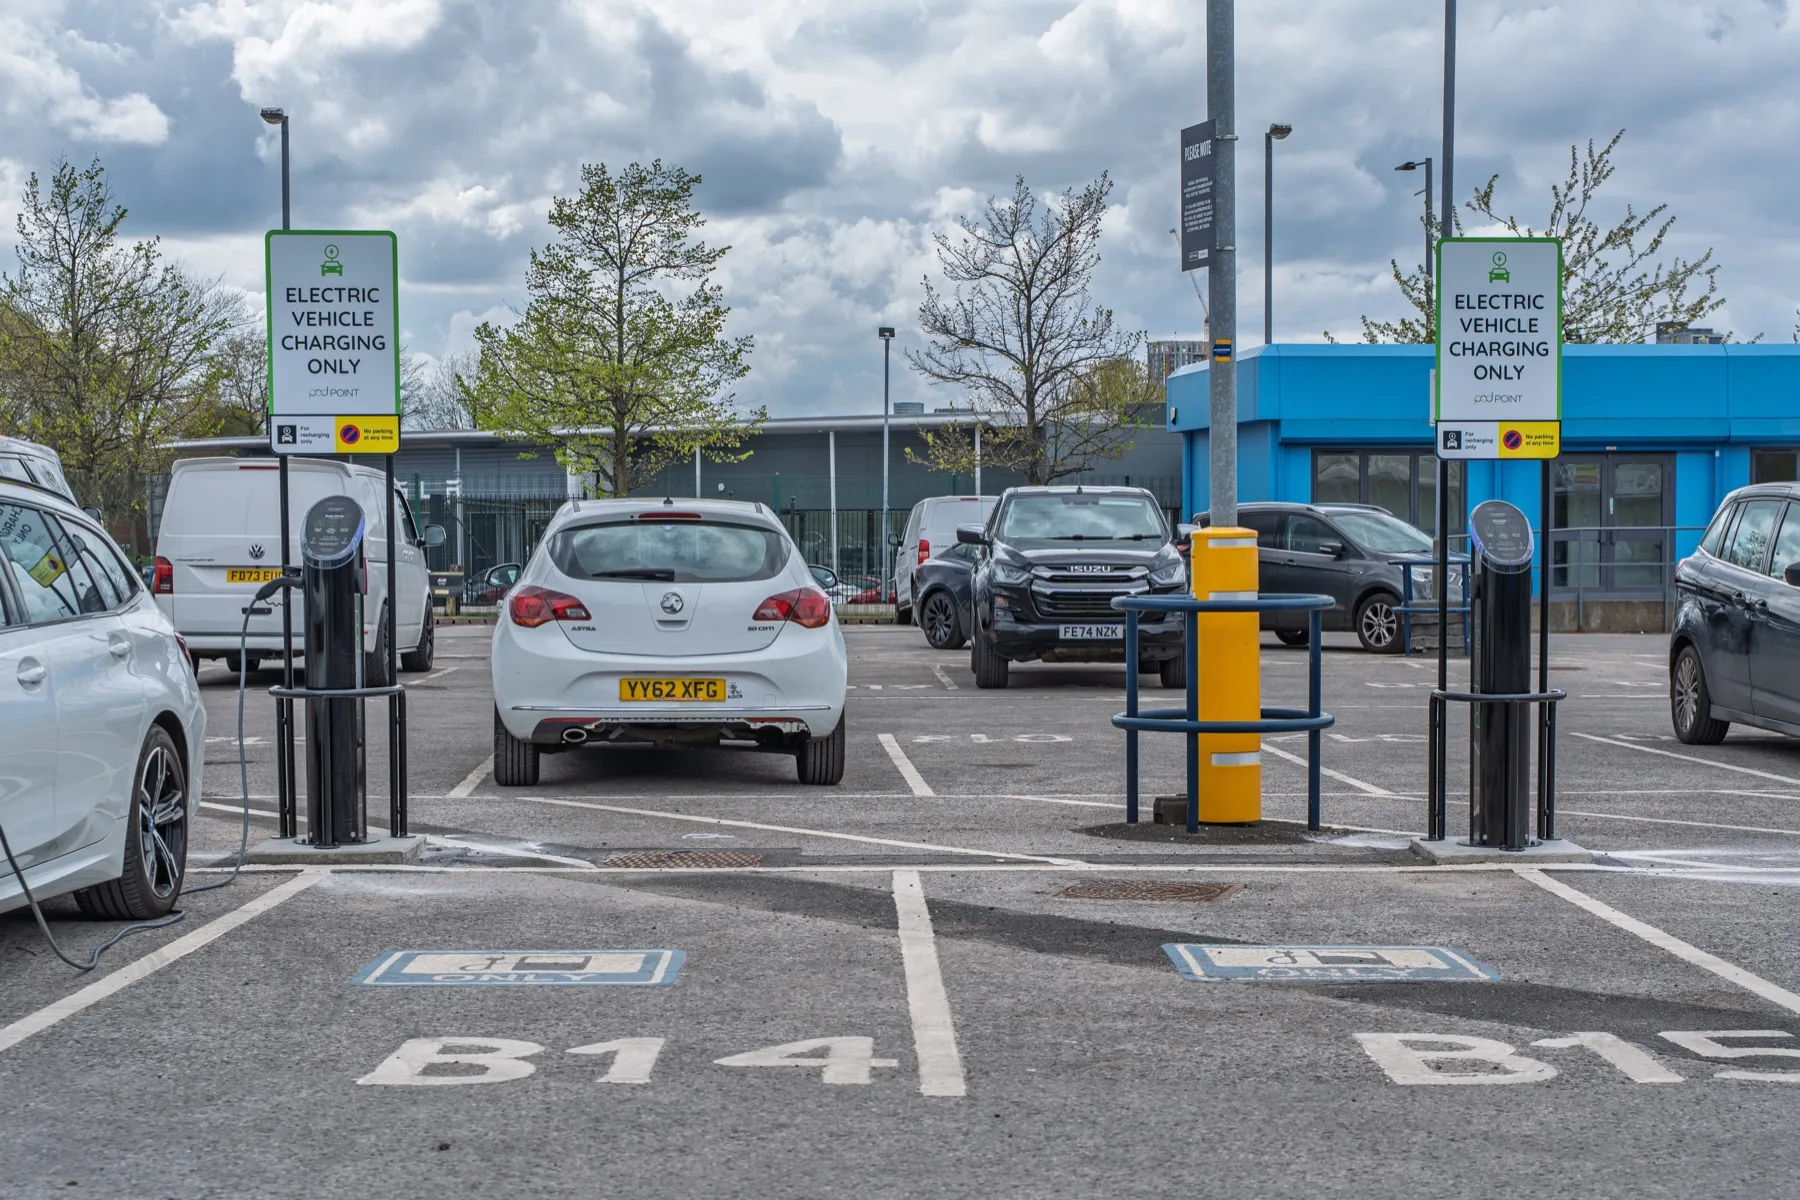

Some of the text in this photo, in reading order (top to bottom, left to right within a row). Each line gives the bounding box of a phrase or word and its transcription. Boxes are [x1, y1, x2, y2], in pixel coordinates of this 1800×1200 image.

[1184, 140, 1212, 162] PLEASE NOTE
[286, 287, 380, 302] ELECTRIC
[1455, 294, 1544, 309] ELECTRIC
[292, 311, 374, 326] VEHICLE
[1460, 318, 1538, 333] VEHICLE
[281, 335, 386, 350] CHARGING
[1450, 341, 1549, 357] CHARGING
[308, 358, 361, 374] ONLY
[1474, 365, 1525, 380] ONLY
[330, 388, 359, 398] POINT
[1495, 394, 1523, 403] POINT
[231, 571, 260, 580] FD73
[1064, 627, 1118, 637] FE74 NZK
[628, 681, 676, 698] YY62
[681, 681, 717, 698] XFG
[432, 972, 602, 983] ONLY
[356, 1036, 898, 1085] B14
